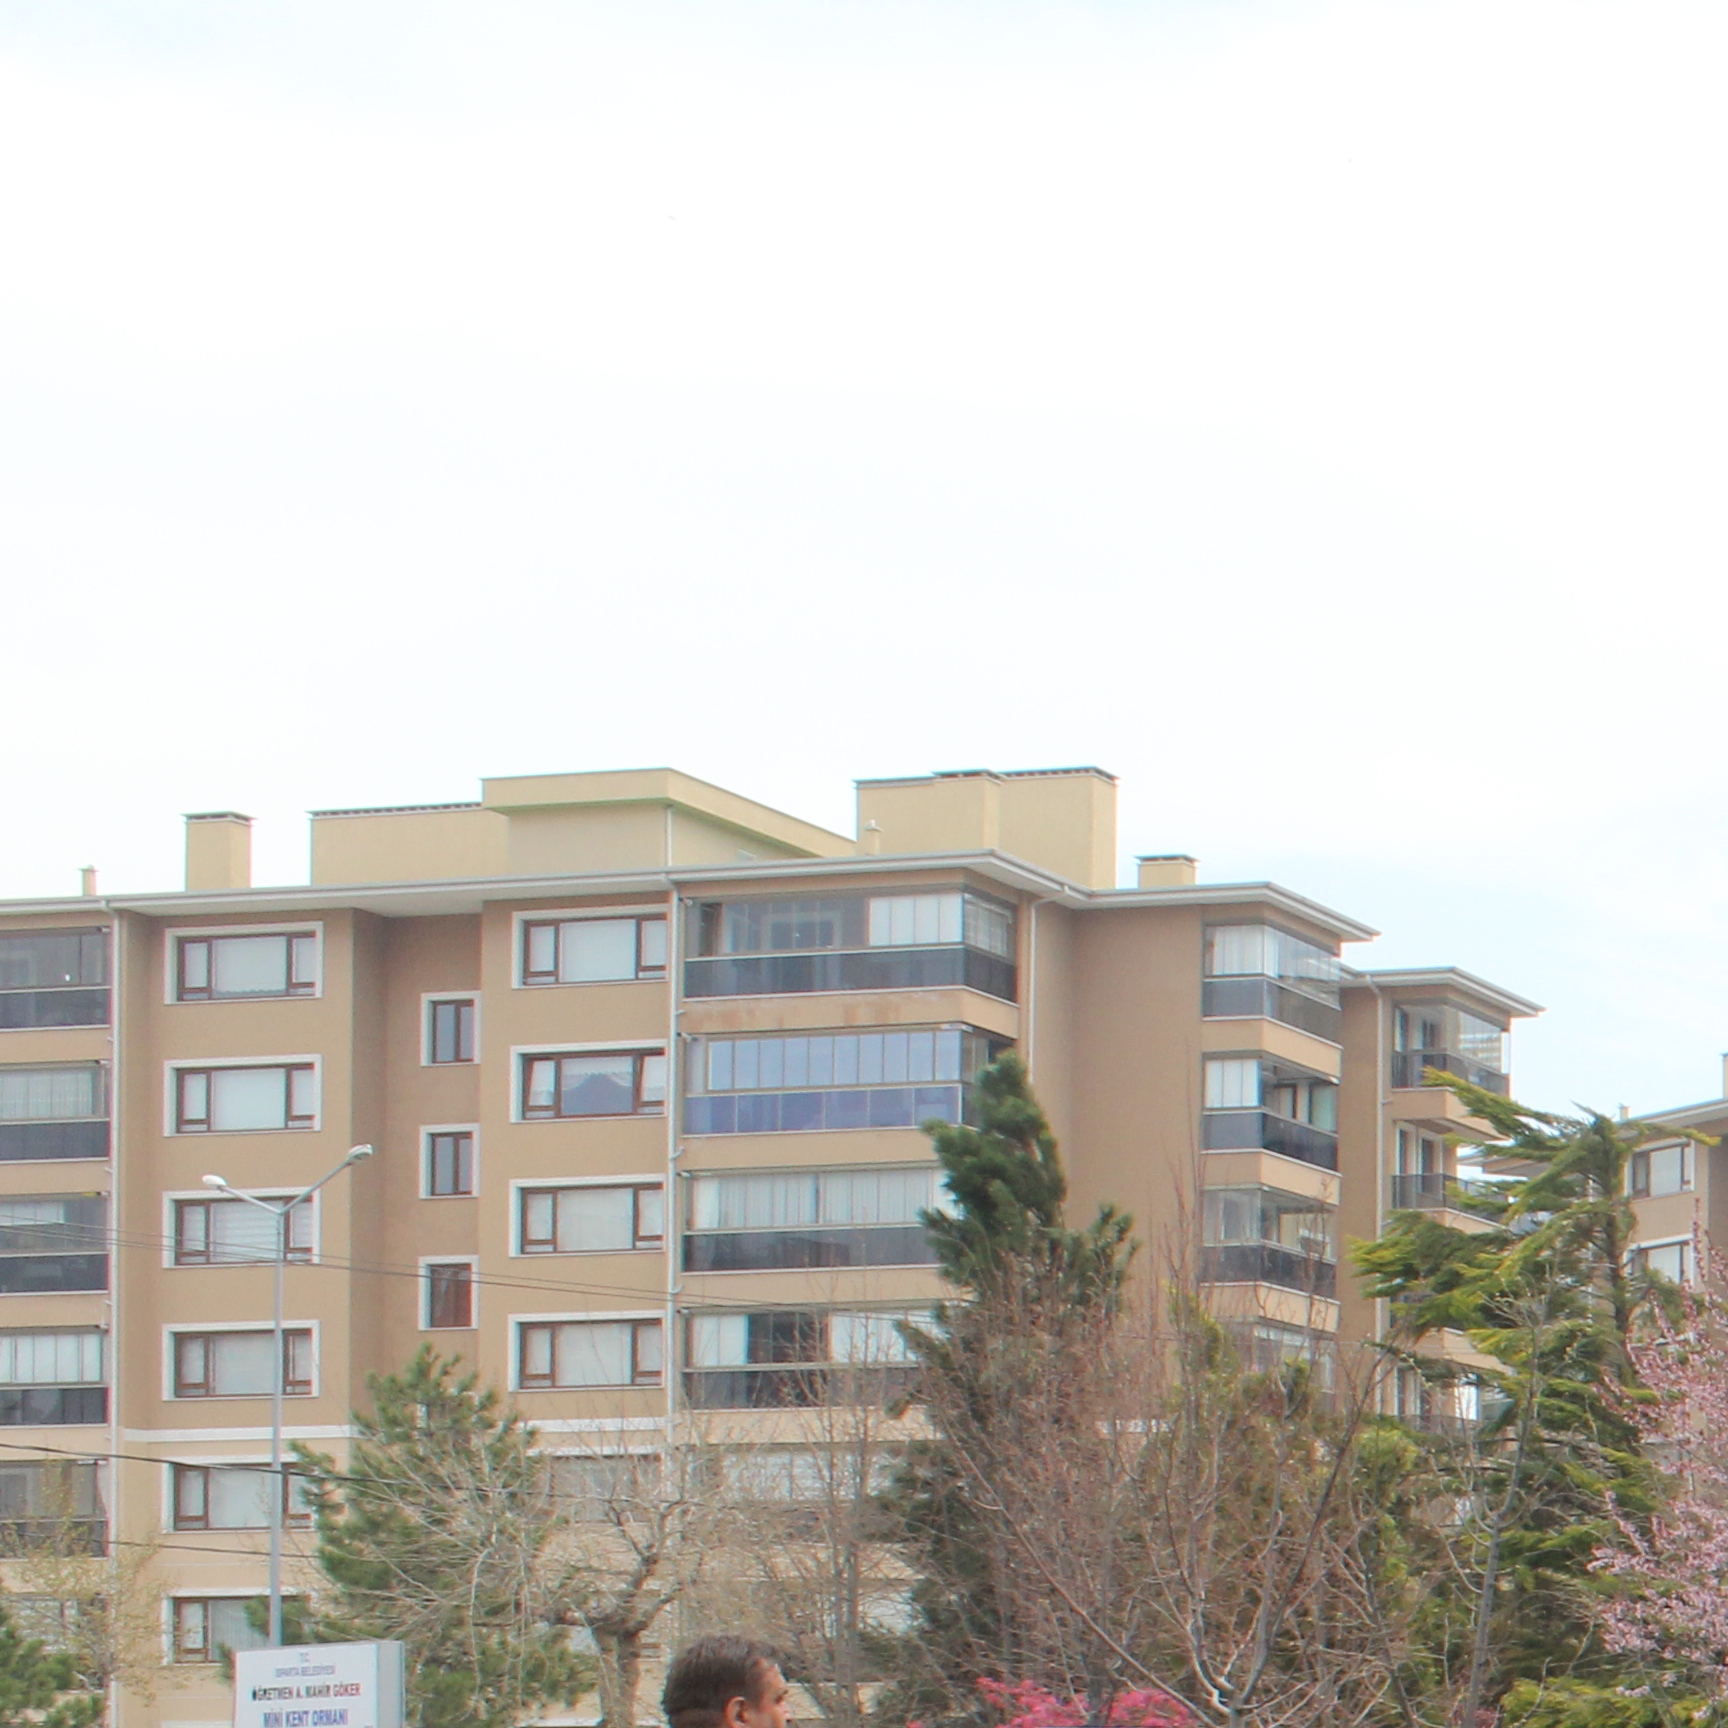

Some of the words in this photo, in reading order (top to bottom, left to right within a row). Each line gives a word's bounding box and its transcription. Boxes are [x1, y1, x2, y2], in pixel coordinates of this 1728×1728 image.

[333, 1681, 361, 1697] GÖKER
[285, 1711, 310, 1728] KENT
[312, 1708, 348, 1727] ORMANI
